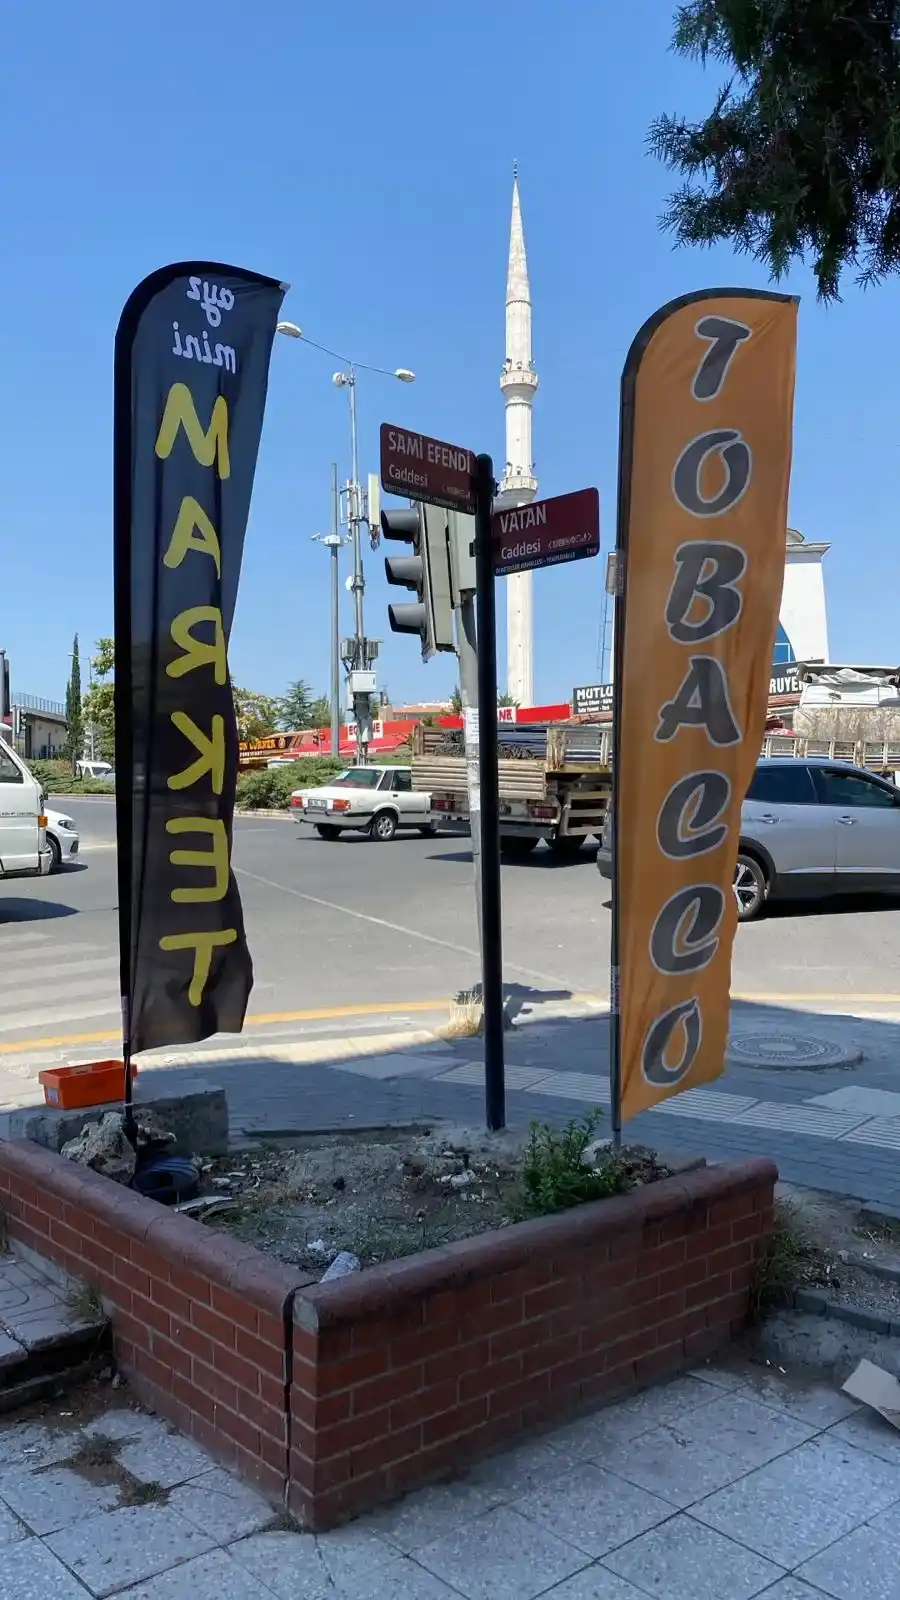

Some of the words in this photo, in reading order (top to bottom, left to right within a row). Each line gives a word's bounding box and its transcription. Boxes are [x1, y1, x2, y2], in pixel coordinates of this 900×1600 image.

[388, 431, 424, 460] SAMİ
[427, 442, 471, 474] EFENDİ
[388, 463, 428, 488] Caddesi
[499, 504, 547, 533] VATAN
[500, 538, 541, 560] Caddesi
[576, 686, 614, 701] MUTLU
[640, 314, 754, 1088] TOBACCO
